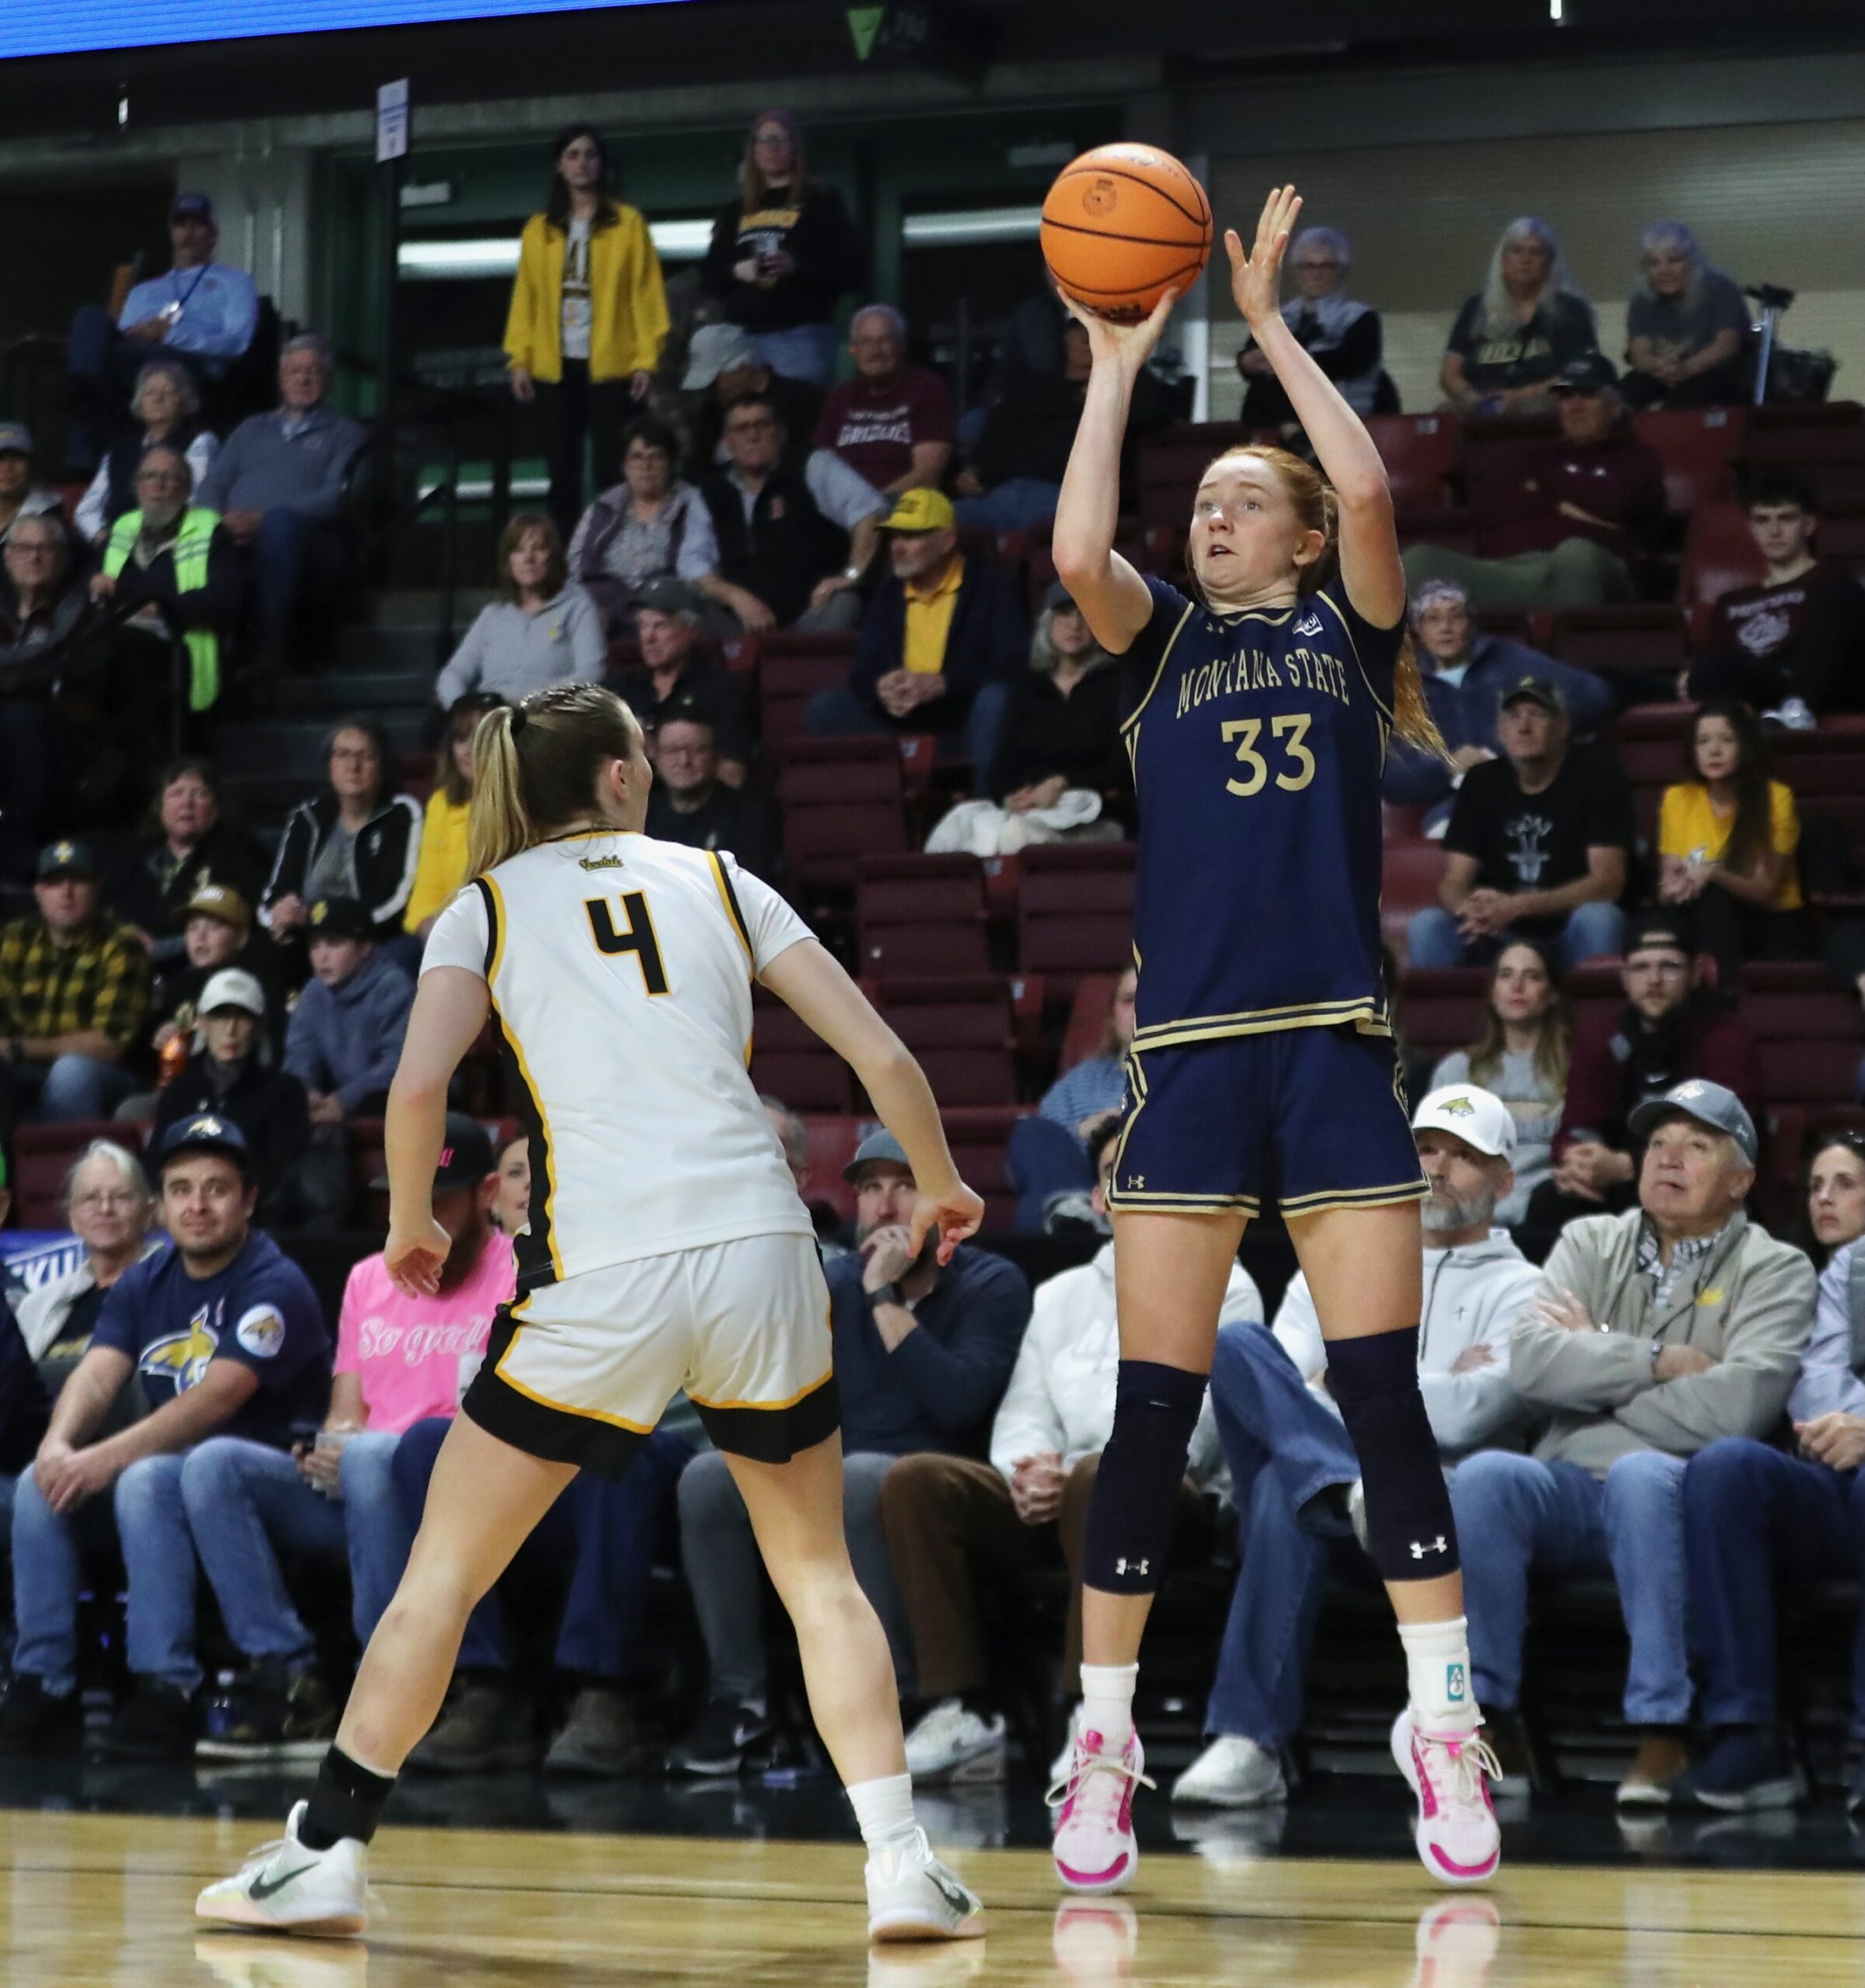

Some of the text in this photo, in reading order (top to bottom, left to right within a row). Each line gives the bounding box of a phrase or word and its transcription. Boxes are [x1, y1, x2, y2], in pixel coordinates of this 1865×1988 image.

[1176, 648, 1350, 719] MONTANA STATE
[1221, 713, 1316, 797] 33
[583, 889, 671, 997] 4
[358, 1316, 404, 1360] So
